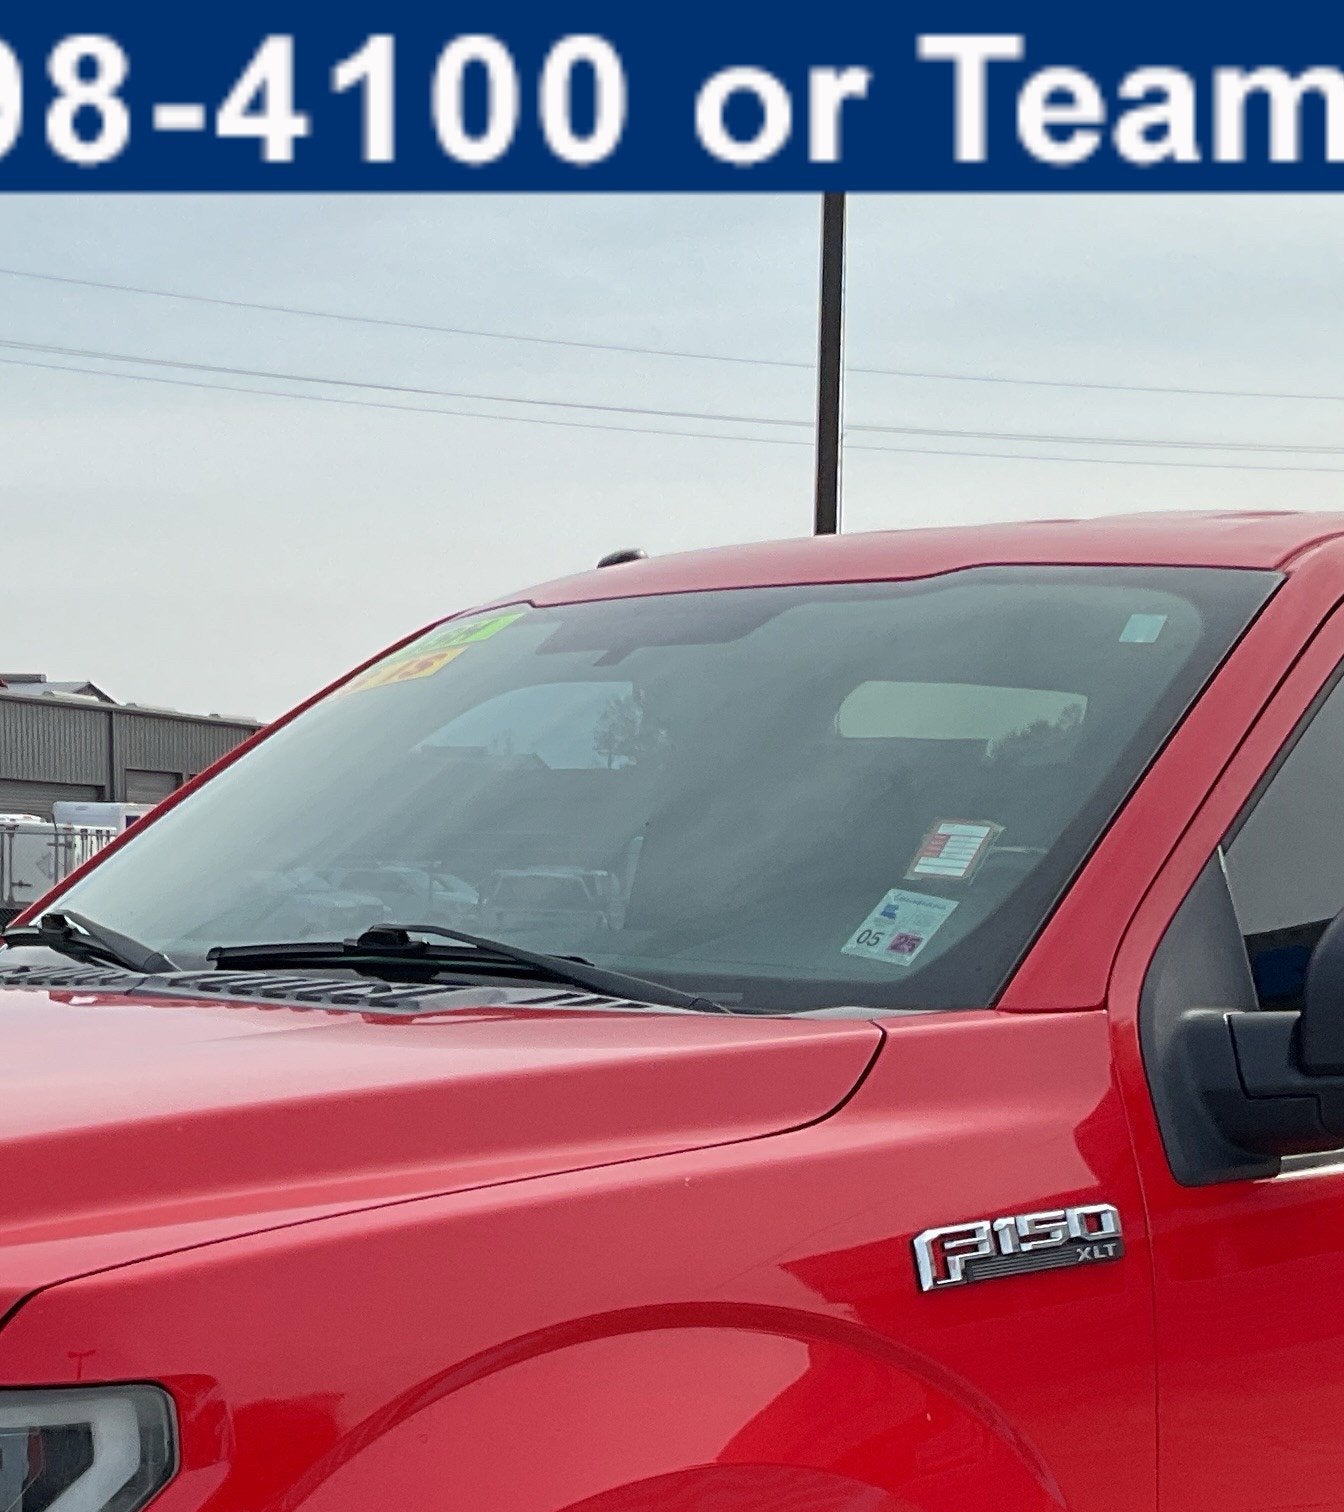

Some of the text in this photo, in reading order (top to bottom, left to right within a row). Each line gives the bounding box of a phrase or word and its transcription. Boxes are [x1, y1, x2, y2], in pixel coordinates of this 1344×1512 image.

[856, 929, 886, 947] 05
[913, 1203, 1122, 1292] F150
[1076, 1243, 1118, 1263] XLT
